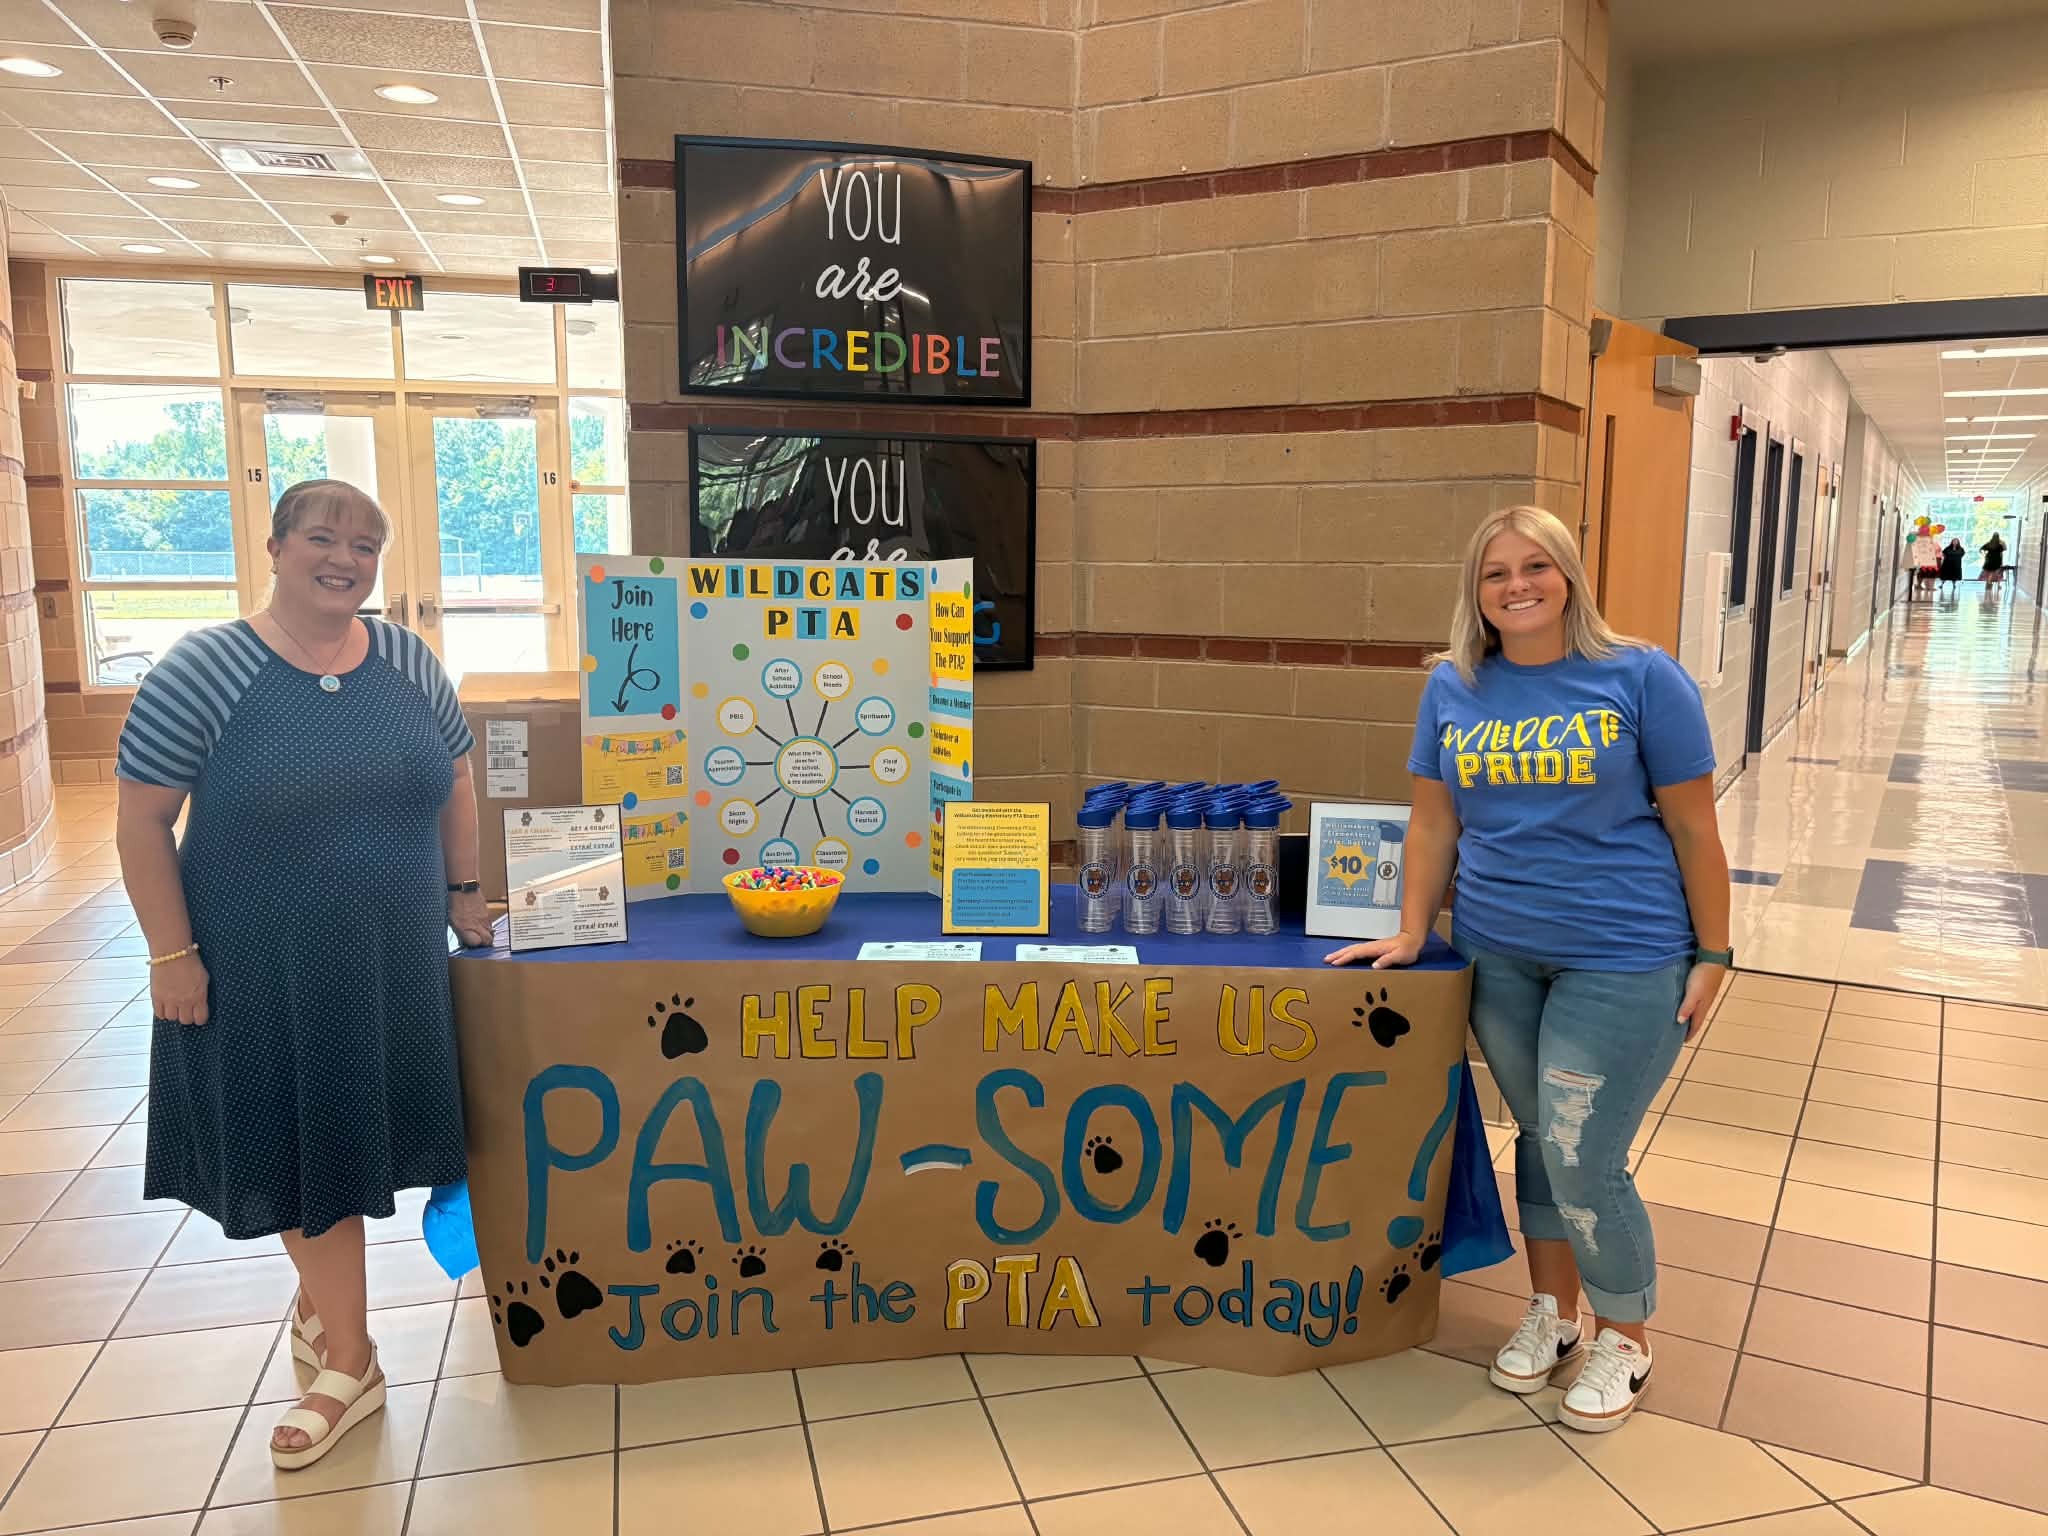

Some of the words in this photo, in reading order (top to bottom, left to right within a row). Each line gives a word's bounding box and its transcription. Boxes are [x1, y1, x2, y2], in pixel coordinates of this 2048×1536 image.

[819, 168, 901, 245] YOU
[375, 278, 415, 308] EXIT
[815, 256, 902, 302] are
[715, 324, 1001, 377] INCREDIBLE
[247, 468, 262, 483] 15
[543, 471, 557, 486] 16
[825, 457, 905, 527] YOU
[611, 580, 654, 609] Join
[691, 567, 920, 598] WILDCATS
[767, 609, 856, 637] PTA
[935, 602, 950, 619] How
[951, 602, 966, 618] Can
[611, 616, 655, 643] Here
[930, 628, 943, 643] You
[943, 628, 972, 649] Support
[935, 652, 947, 668] The
[948, 653, 966, 671] PTA?
[1456, 748, 1597, 789] PRIDE
[819, 858, 844, 866] Support
[1330, 855, 1362, 875] $10
[741, 983, 942, 1060] HELP
[982, 978, 1178, 1059] MAKE
[1216, 983, 1318, 1062] US
[607, 1274, 780, 1351] Join
[810, 1263, 916, 1330] the
[943, 1253, 1101, 1330] PTA
[1126, 1258, 1363, 1348] today!
